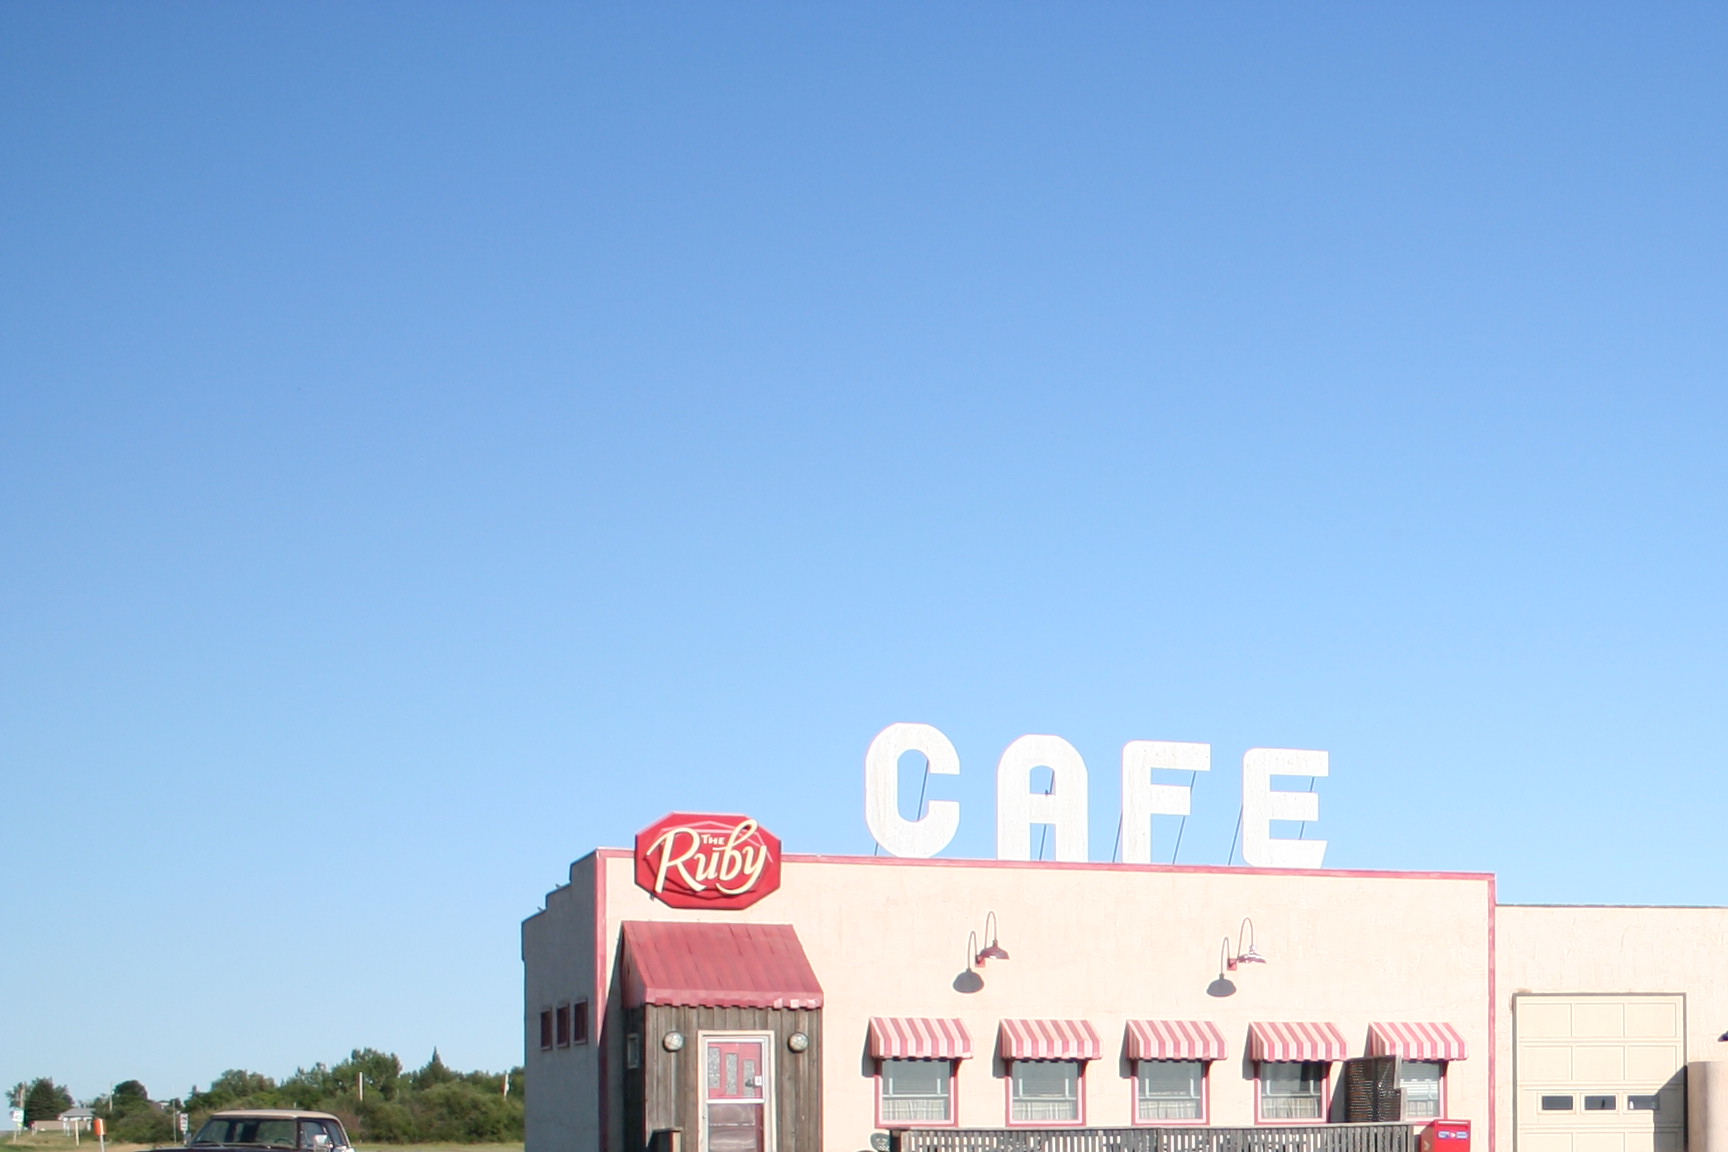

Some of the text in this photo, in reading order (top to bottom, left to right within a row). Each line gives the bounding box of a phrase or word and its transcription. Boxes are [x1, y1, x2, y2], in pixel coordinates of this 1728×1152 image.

[865, 722, 1329, 869] CAFE
[646, 819, 767, 895] Ruby
[701, 834, 726, 845] THE
